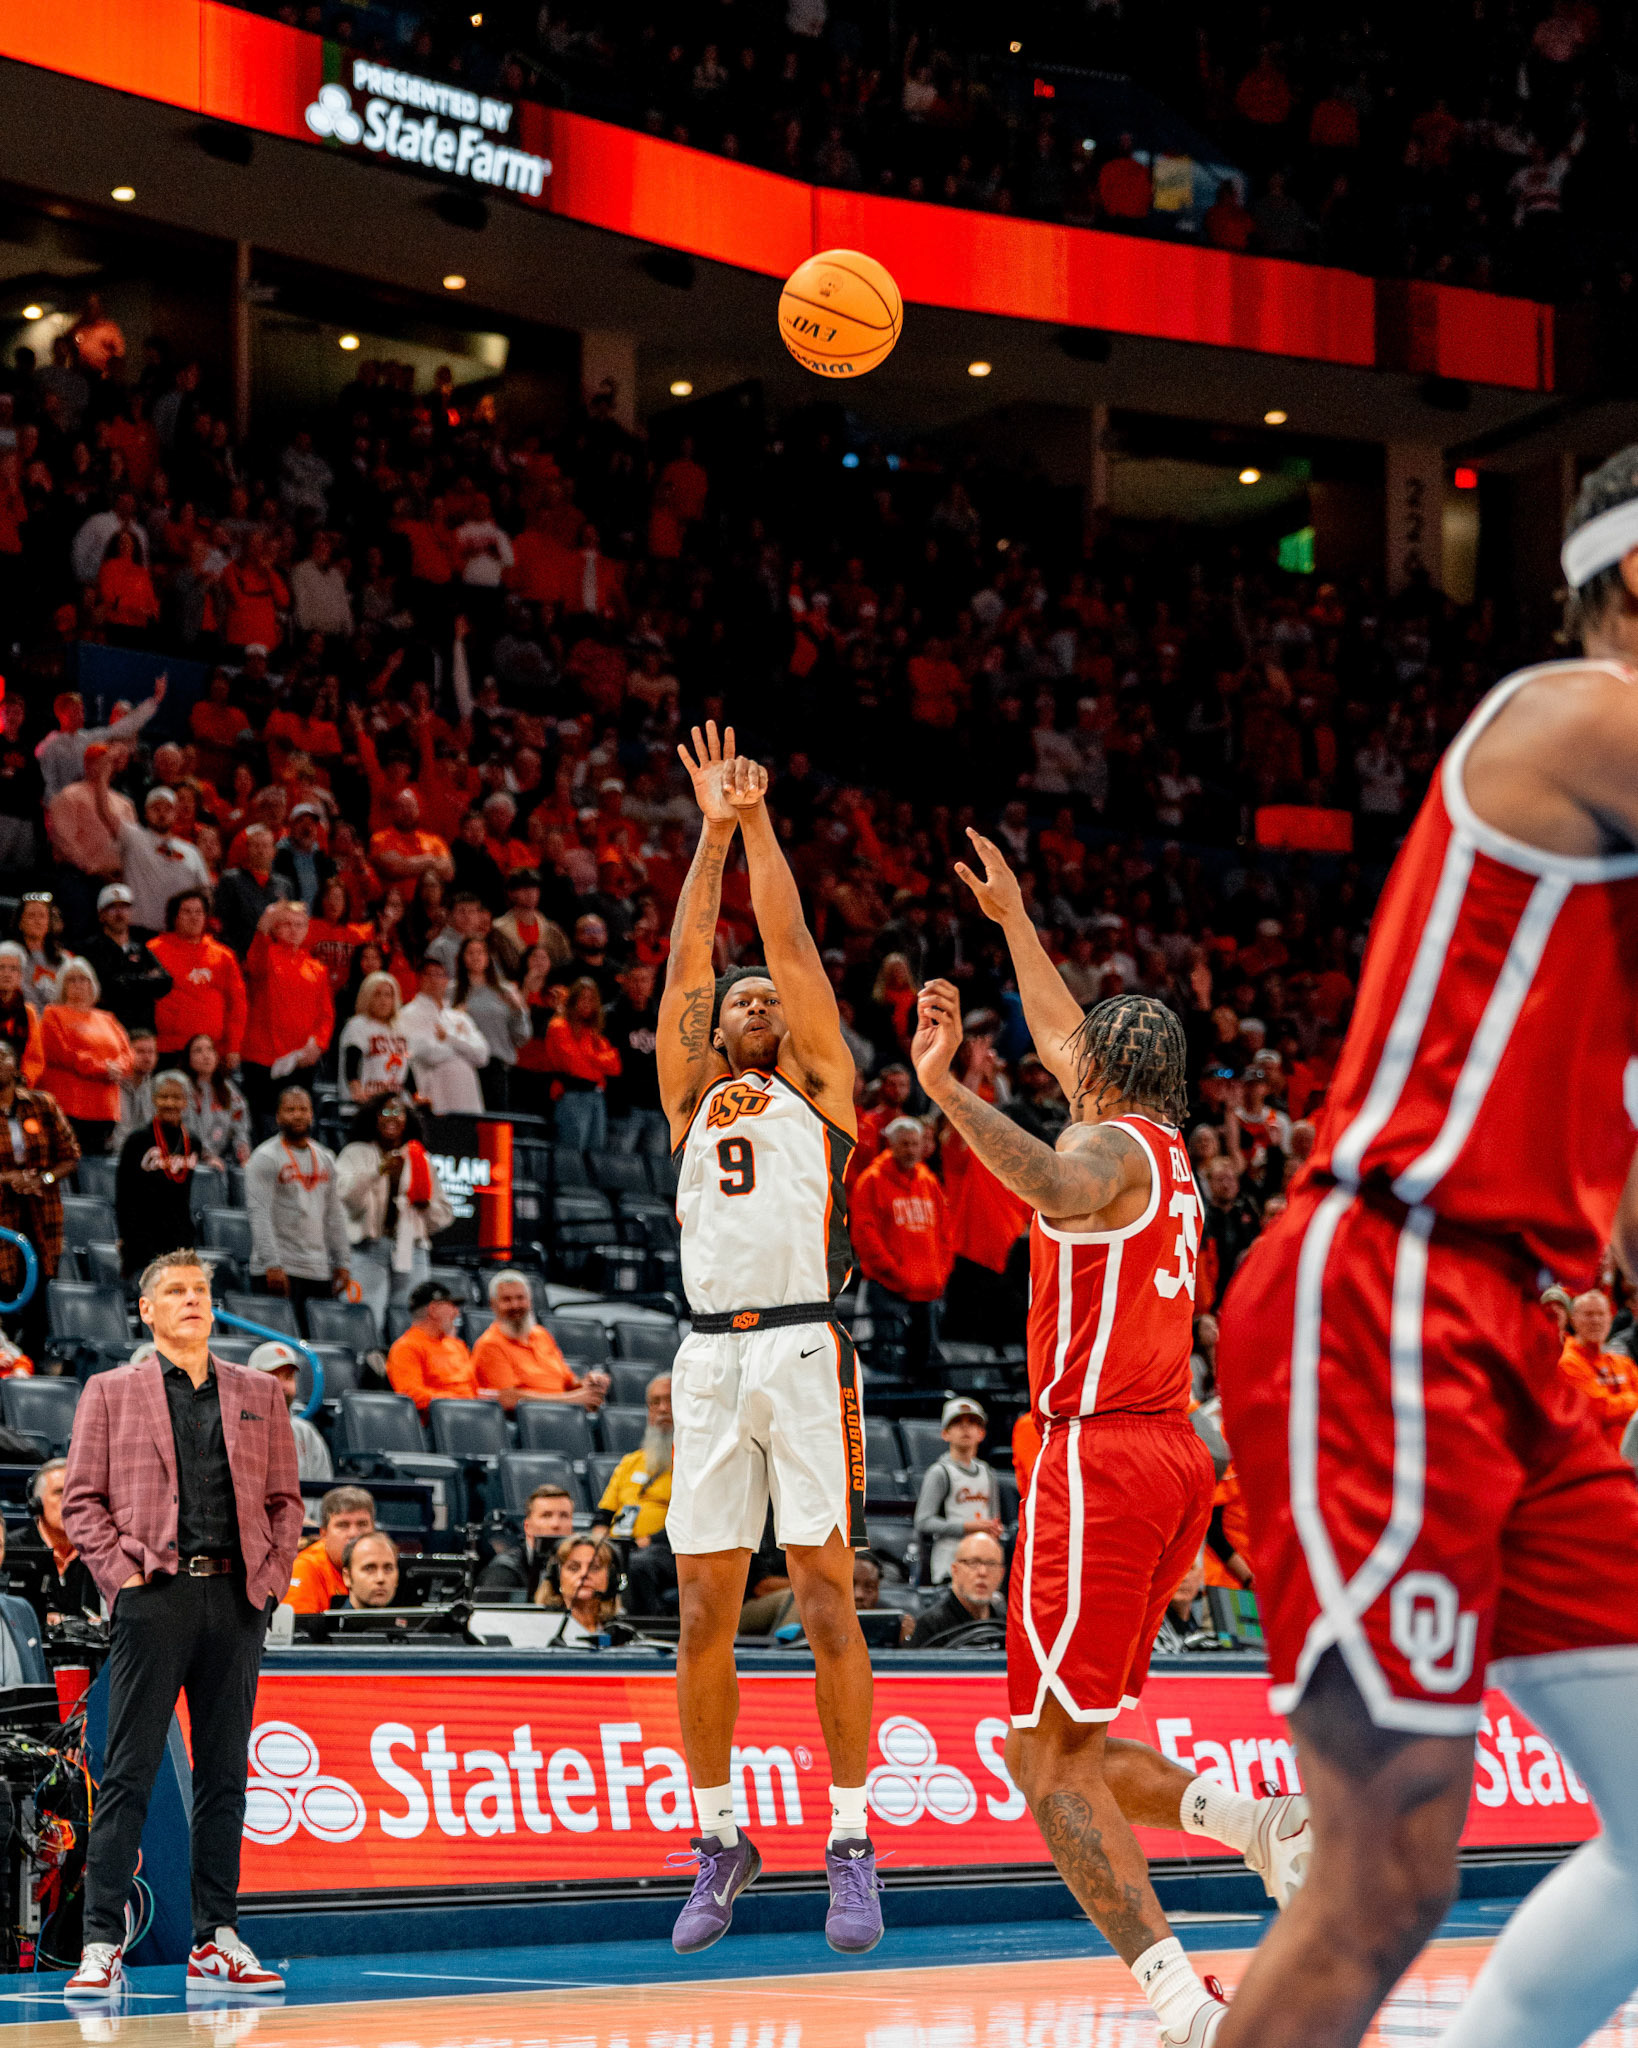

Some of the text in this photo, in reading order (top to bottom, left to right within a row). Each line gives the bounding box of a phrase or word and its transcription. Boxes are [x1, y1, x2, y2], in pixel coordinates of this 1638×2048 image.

[353, 58, 513, 134] PRESENTED BY
[706, 1083, 773, 1130] OSU
[716, 1136, 756, 1197] 9
[732, 1312, 760, 1330] OSU
[842, 1387, 866, 1491] COWBOYS
[1390, 1570, 1479, 1694] OU
[369, 1721, 804, 1840] StateFam
